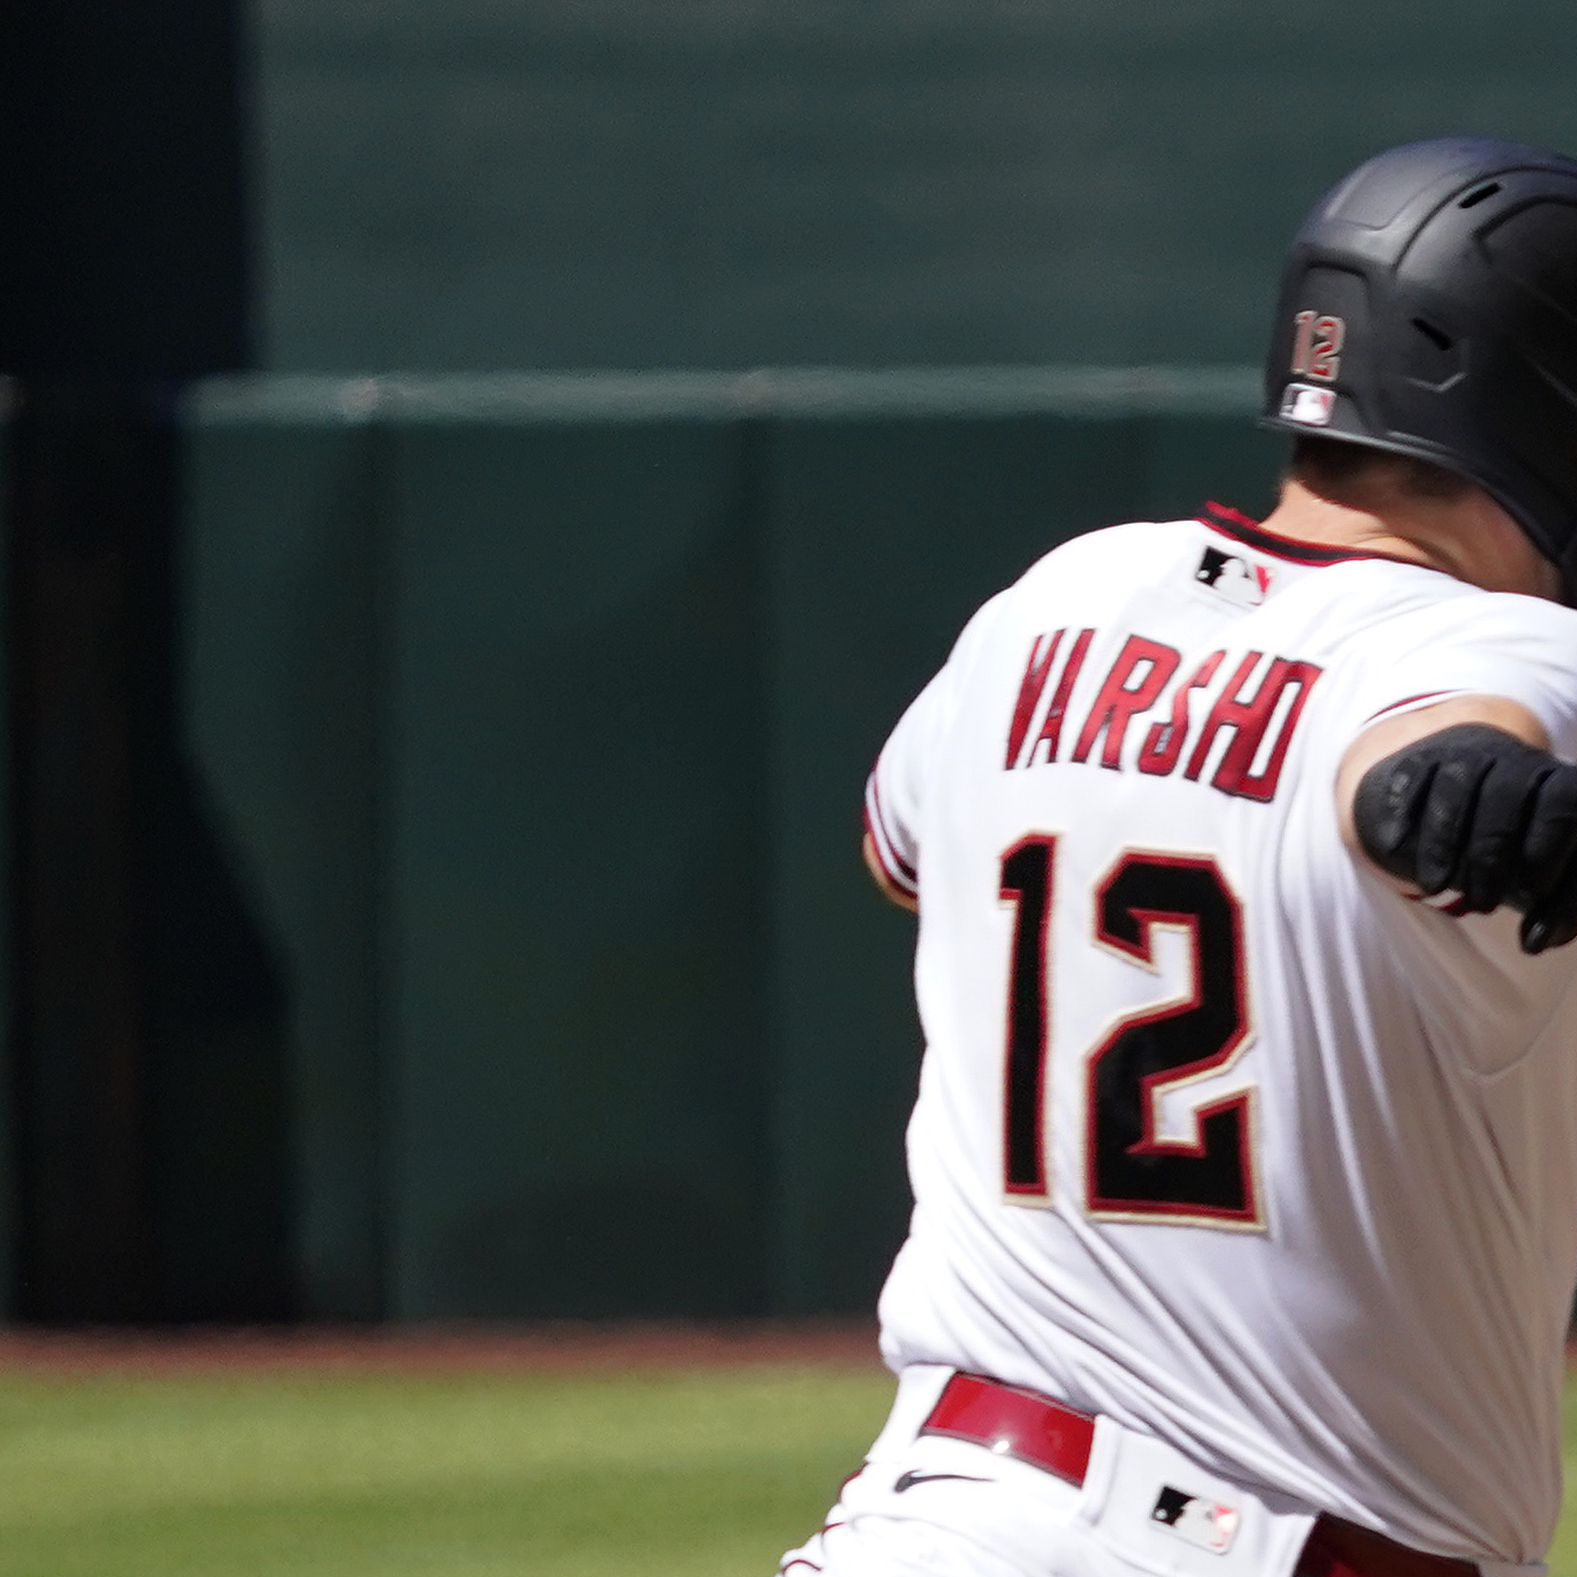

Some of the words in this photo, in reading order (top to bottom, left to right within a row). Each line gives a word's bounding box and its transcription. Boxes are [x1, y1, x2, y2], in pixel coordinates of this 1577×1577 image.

[1290, 310, 1346, 382] 12
[1003, 628, 1323, 804] VARSHO
[998, 829, 1268, 1231] 12
